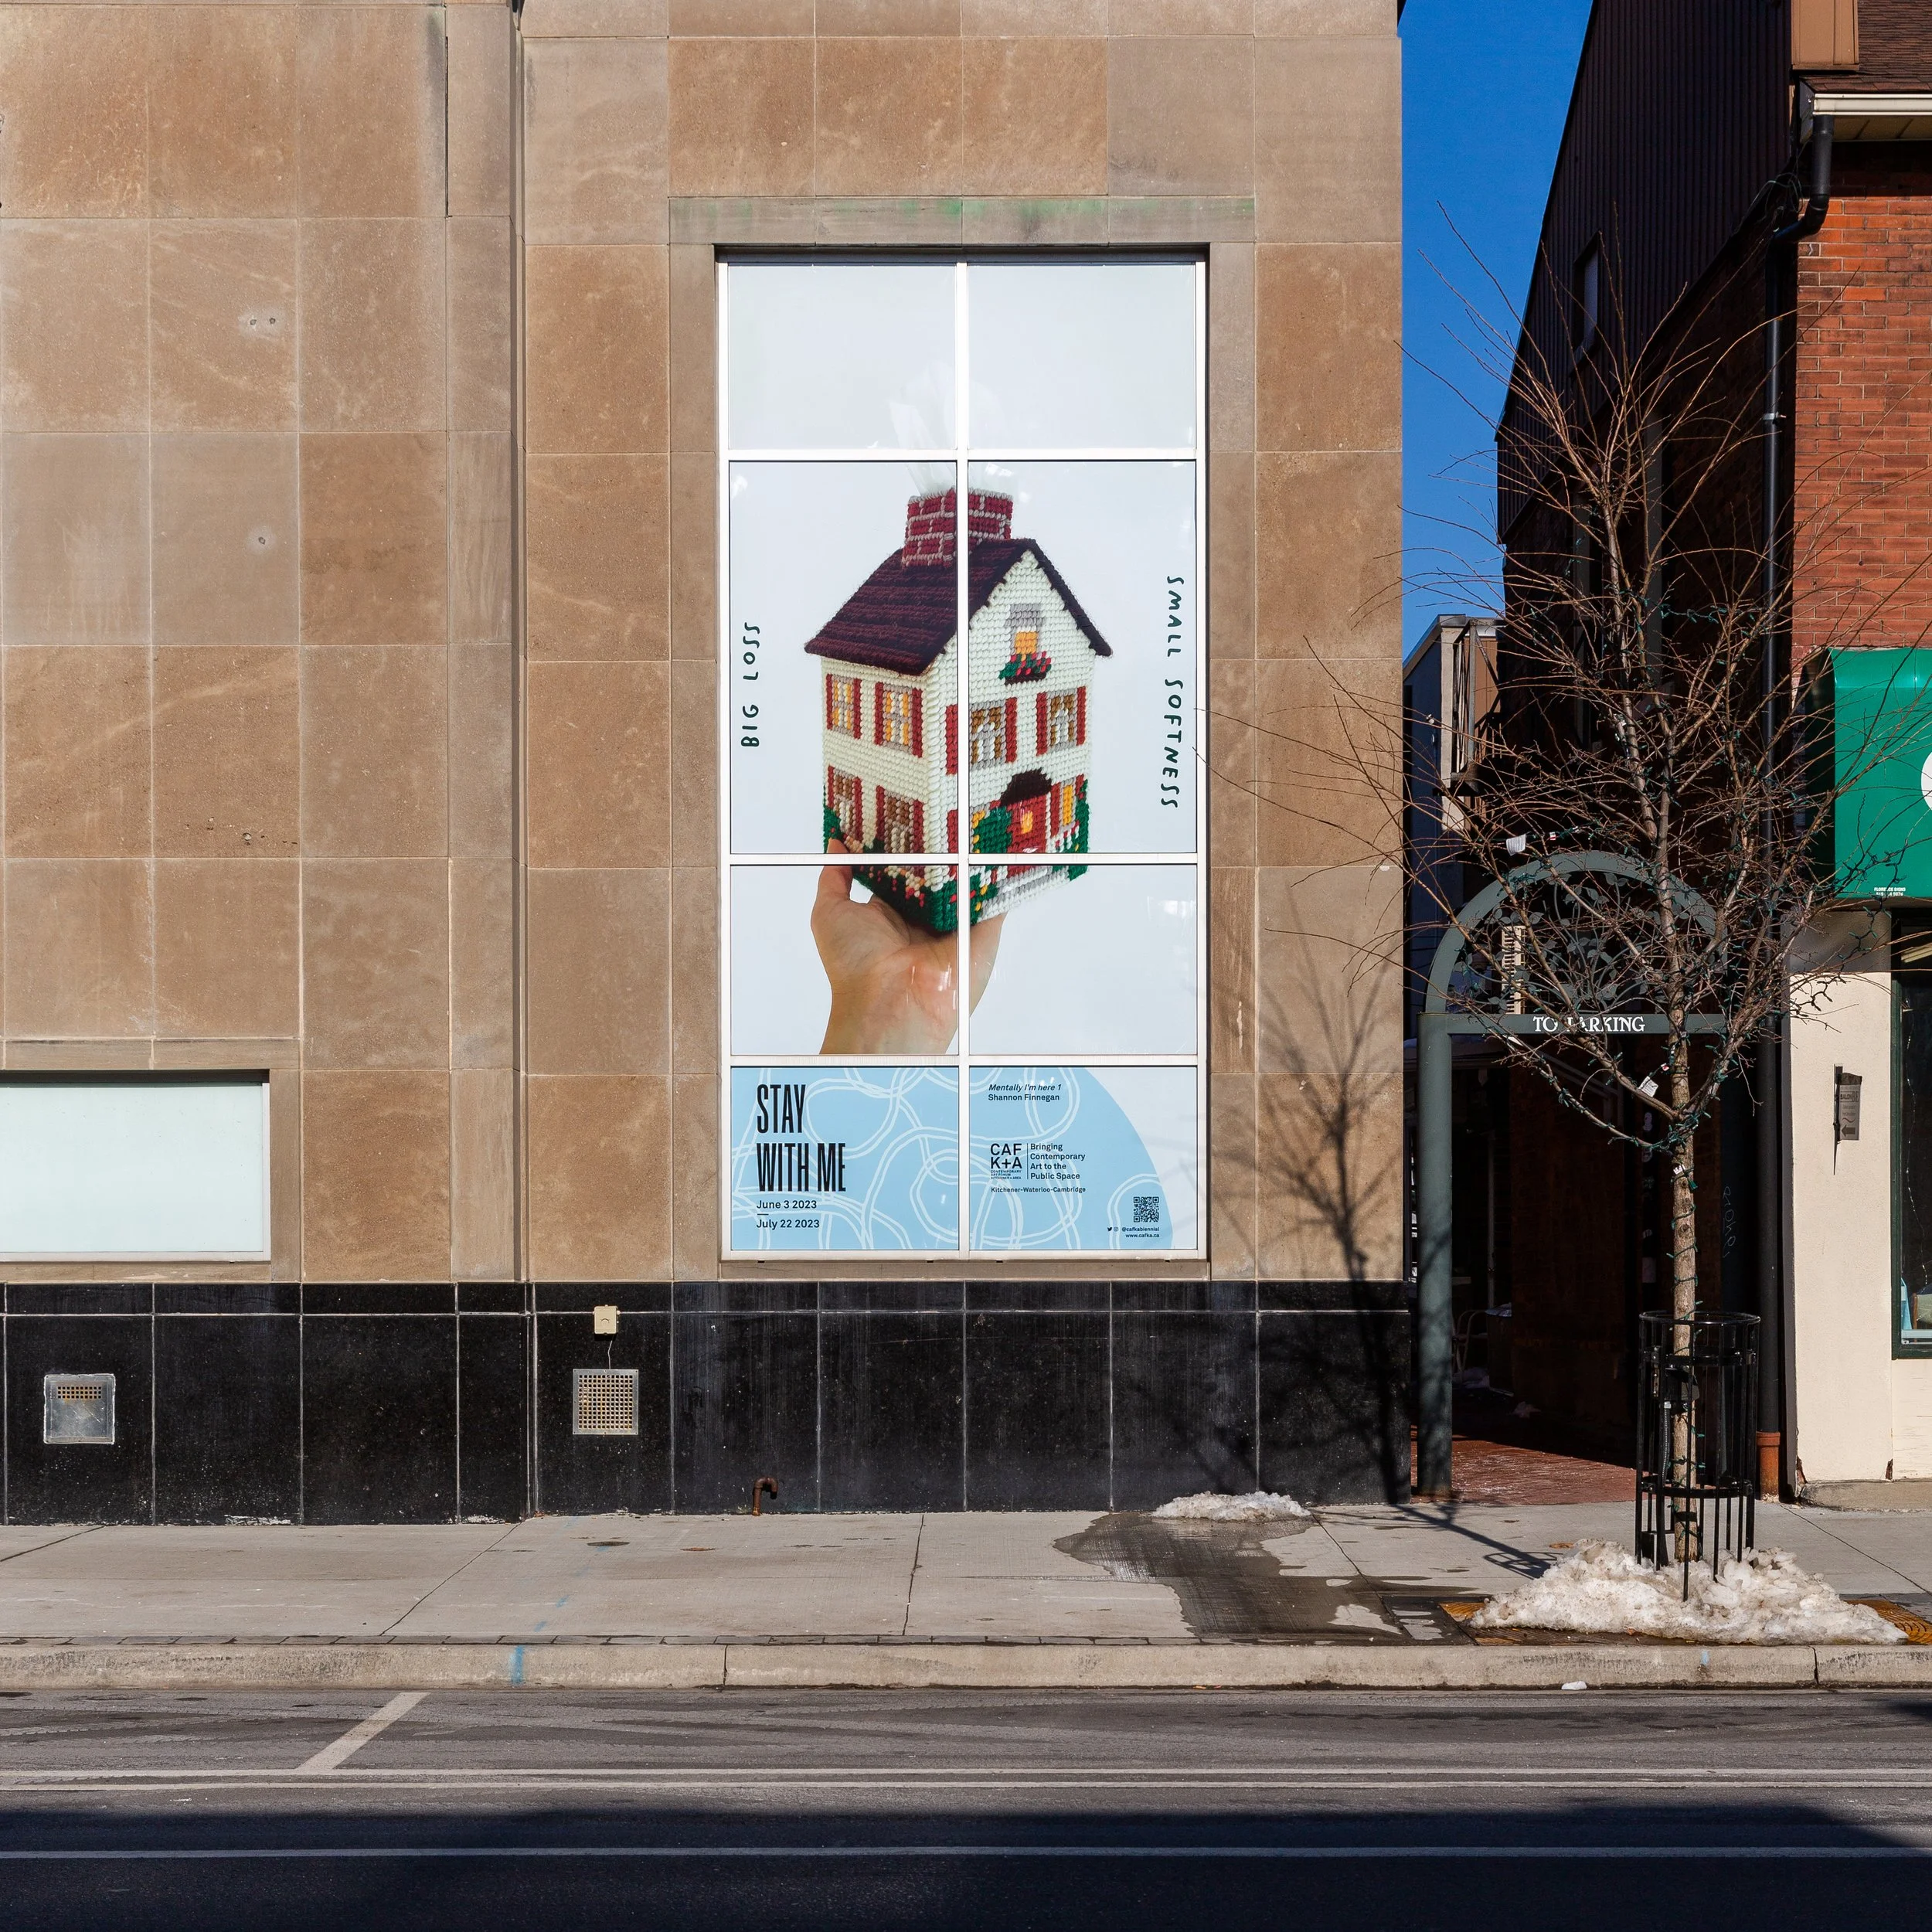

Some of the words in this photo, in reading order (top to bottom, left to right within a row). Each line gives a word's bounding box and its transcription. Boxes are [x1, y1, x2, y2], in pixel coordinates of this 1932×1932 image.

[1167, 576, 1185, 657] SMALL
[743, 621, 760, 681] LOSS
[740, 704, 760, 747] BIG
[1161, 679, 1183, 808] SOFTNESS
[1532, 1016, 1558, 1032] TO
[988, 1083, 1022, 1093] Mentally
[1024, 1094, 1060, 1103] Finnegan
[757, 1084, 806, 1134] STAY
[990, 1143, 1022, 1155] CAF
[1030, 1143, 1063, 1151] Bringing
[757, 1143, 810, 1192] WITH
[817, 1143, 846, 1192] ME
[990, 1157, 1022, 1168] K+A
[1056, 1172, 1080, 1181] Space
[757, 1199, 781, 1209] June
[783, 1199, 790, 1209] 3
[792, 1199, 817, 1209] 2023
[756, 1219, 778, 1230] July
[780, 1219, 792, 1228] 22
[794, 1219, 820, 1228] 2023
